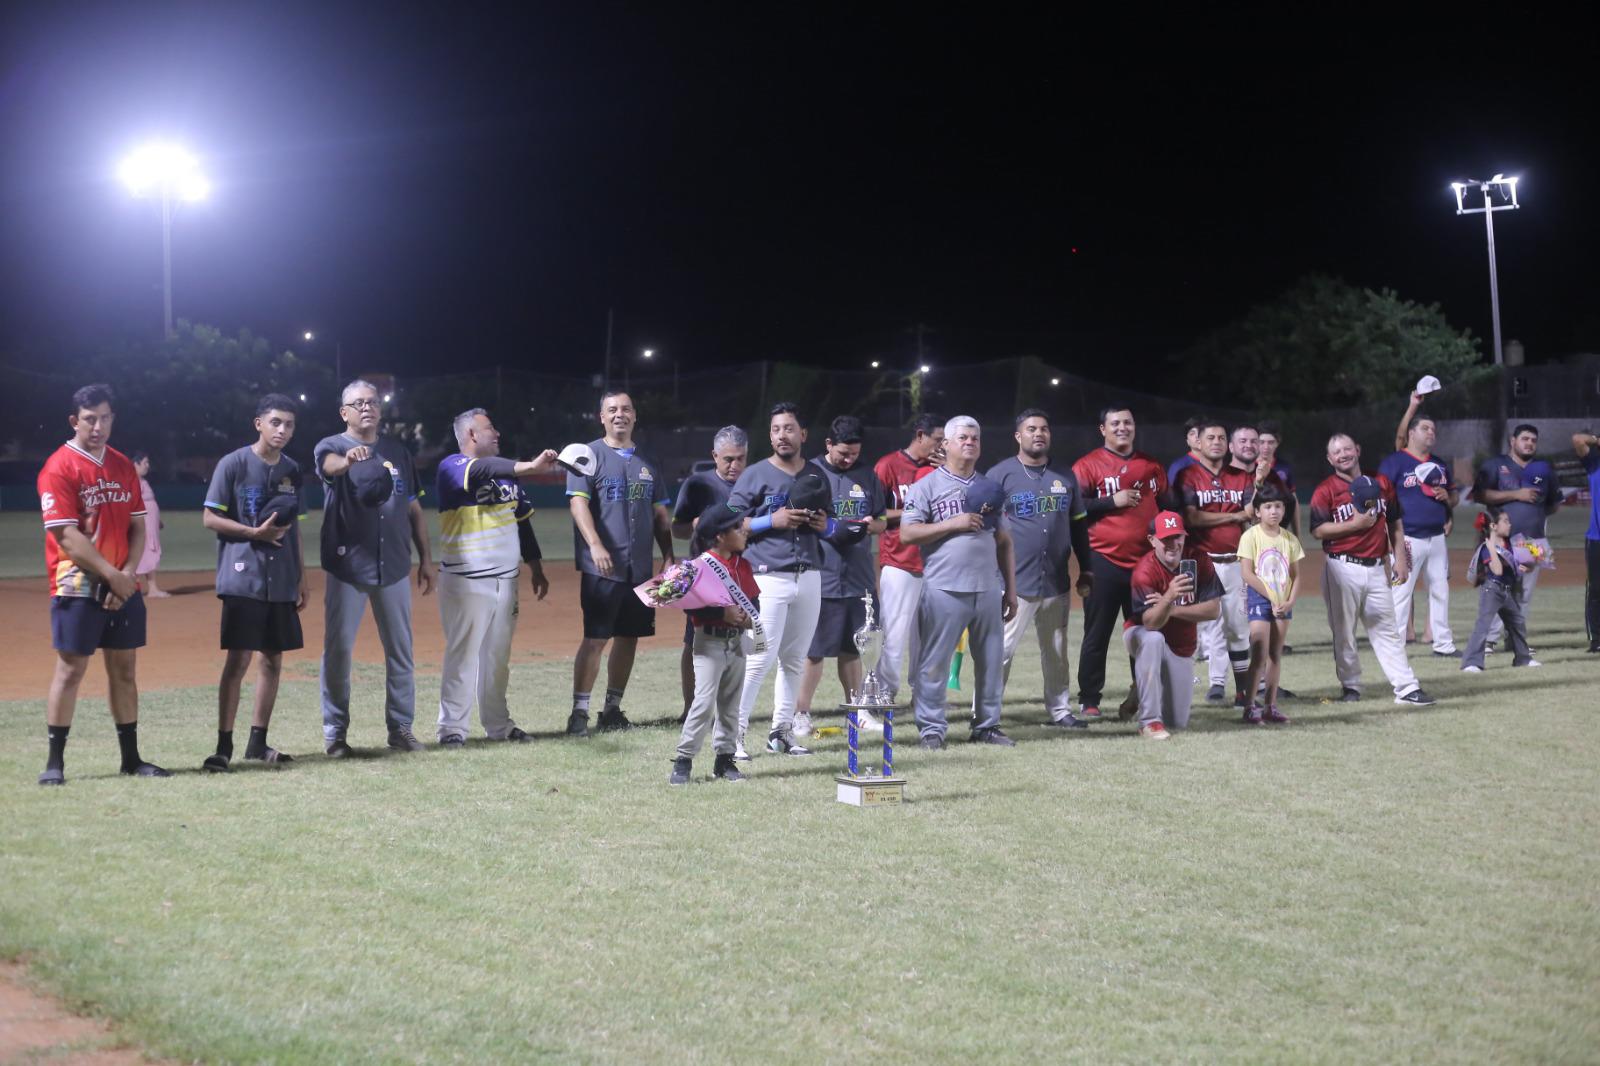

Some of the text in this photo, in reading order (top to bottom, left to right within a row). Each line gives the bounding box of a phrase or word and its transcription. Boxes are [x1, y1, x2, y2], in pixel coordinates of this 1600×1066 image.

[1015, 495, 1070, 518] ESTATE
[1164, 517, 1177, 529] M
[704, 557, 727, 580] ACOS
